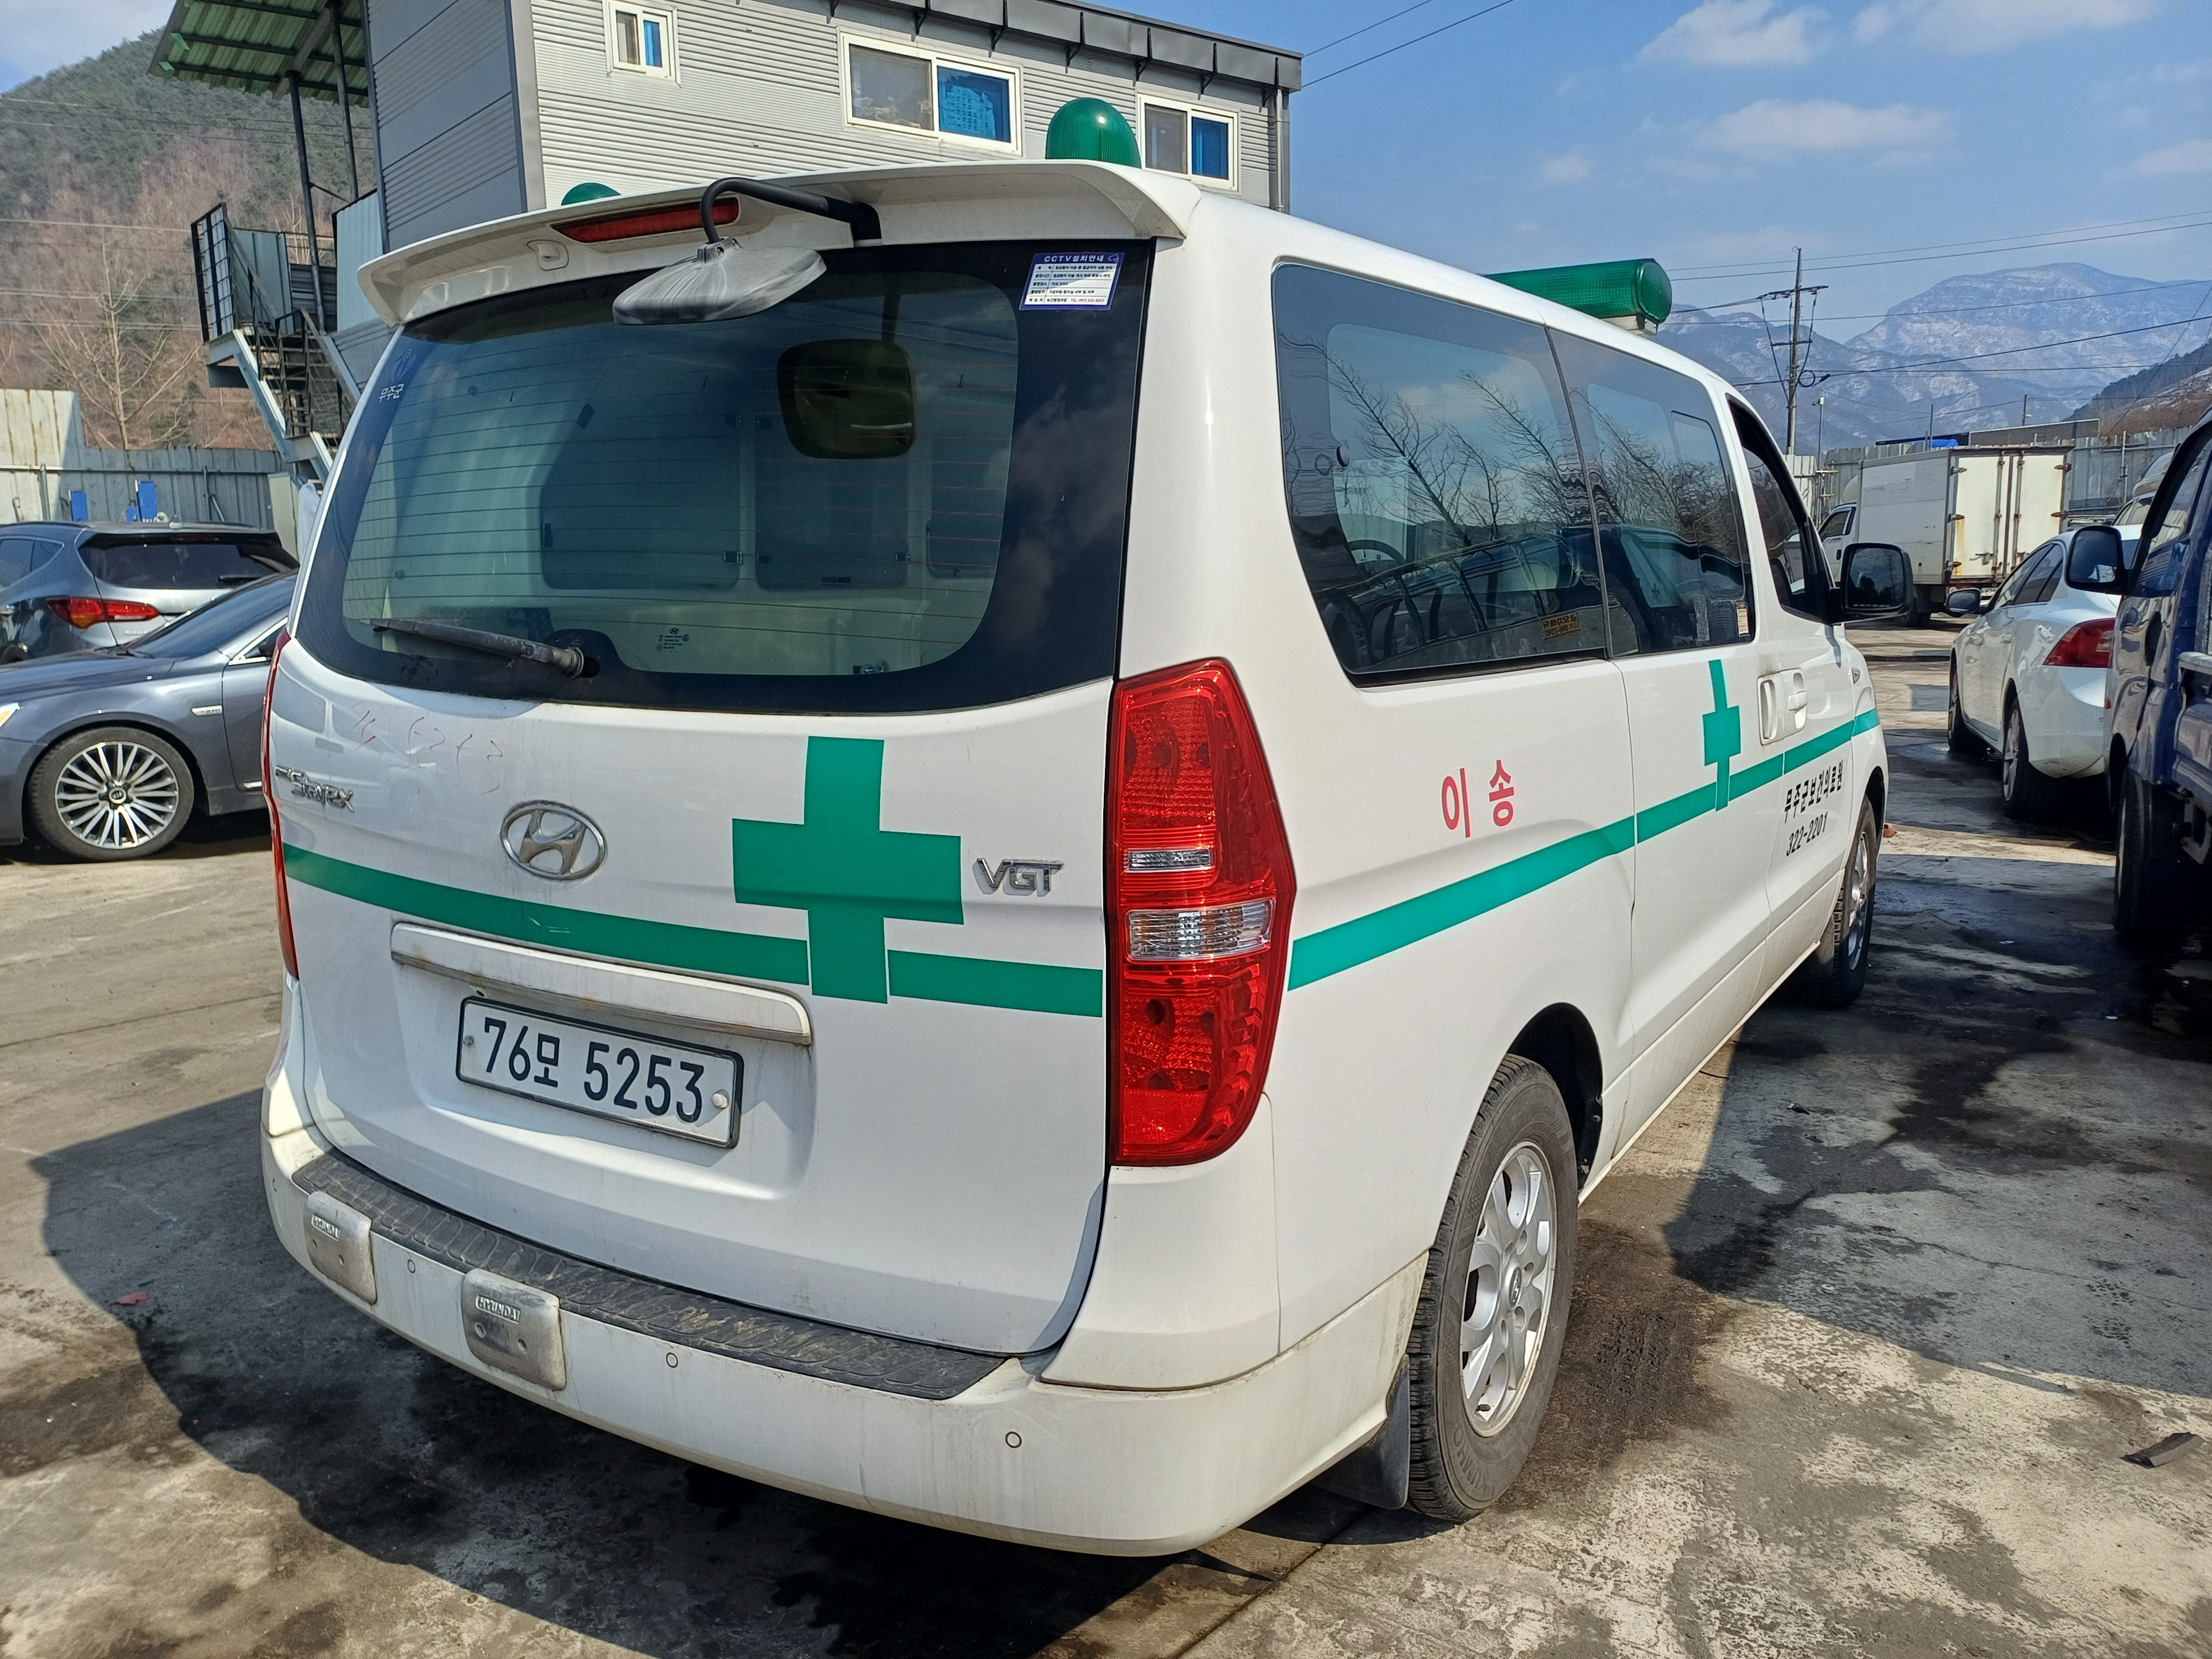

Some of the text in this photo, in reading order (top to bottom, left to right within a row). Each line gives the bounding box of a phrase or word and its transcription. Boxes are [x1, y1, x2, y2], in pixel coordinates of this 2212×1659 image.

[379, 383, 404, 403] 무주군
[1786, 811, 1828, 857] 322-2201
[977, 858, 1065, 892] VGT
[484, 1016, 705, 1124] 76모 5253
[479, 1296, 520, 1322] HYUNDAI
